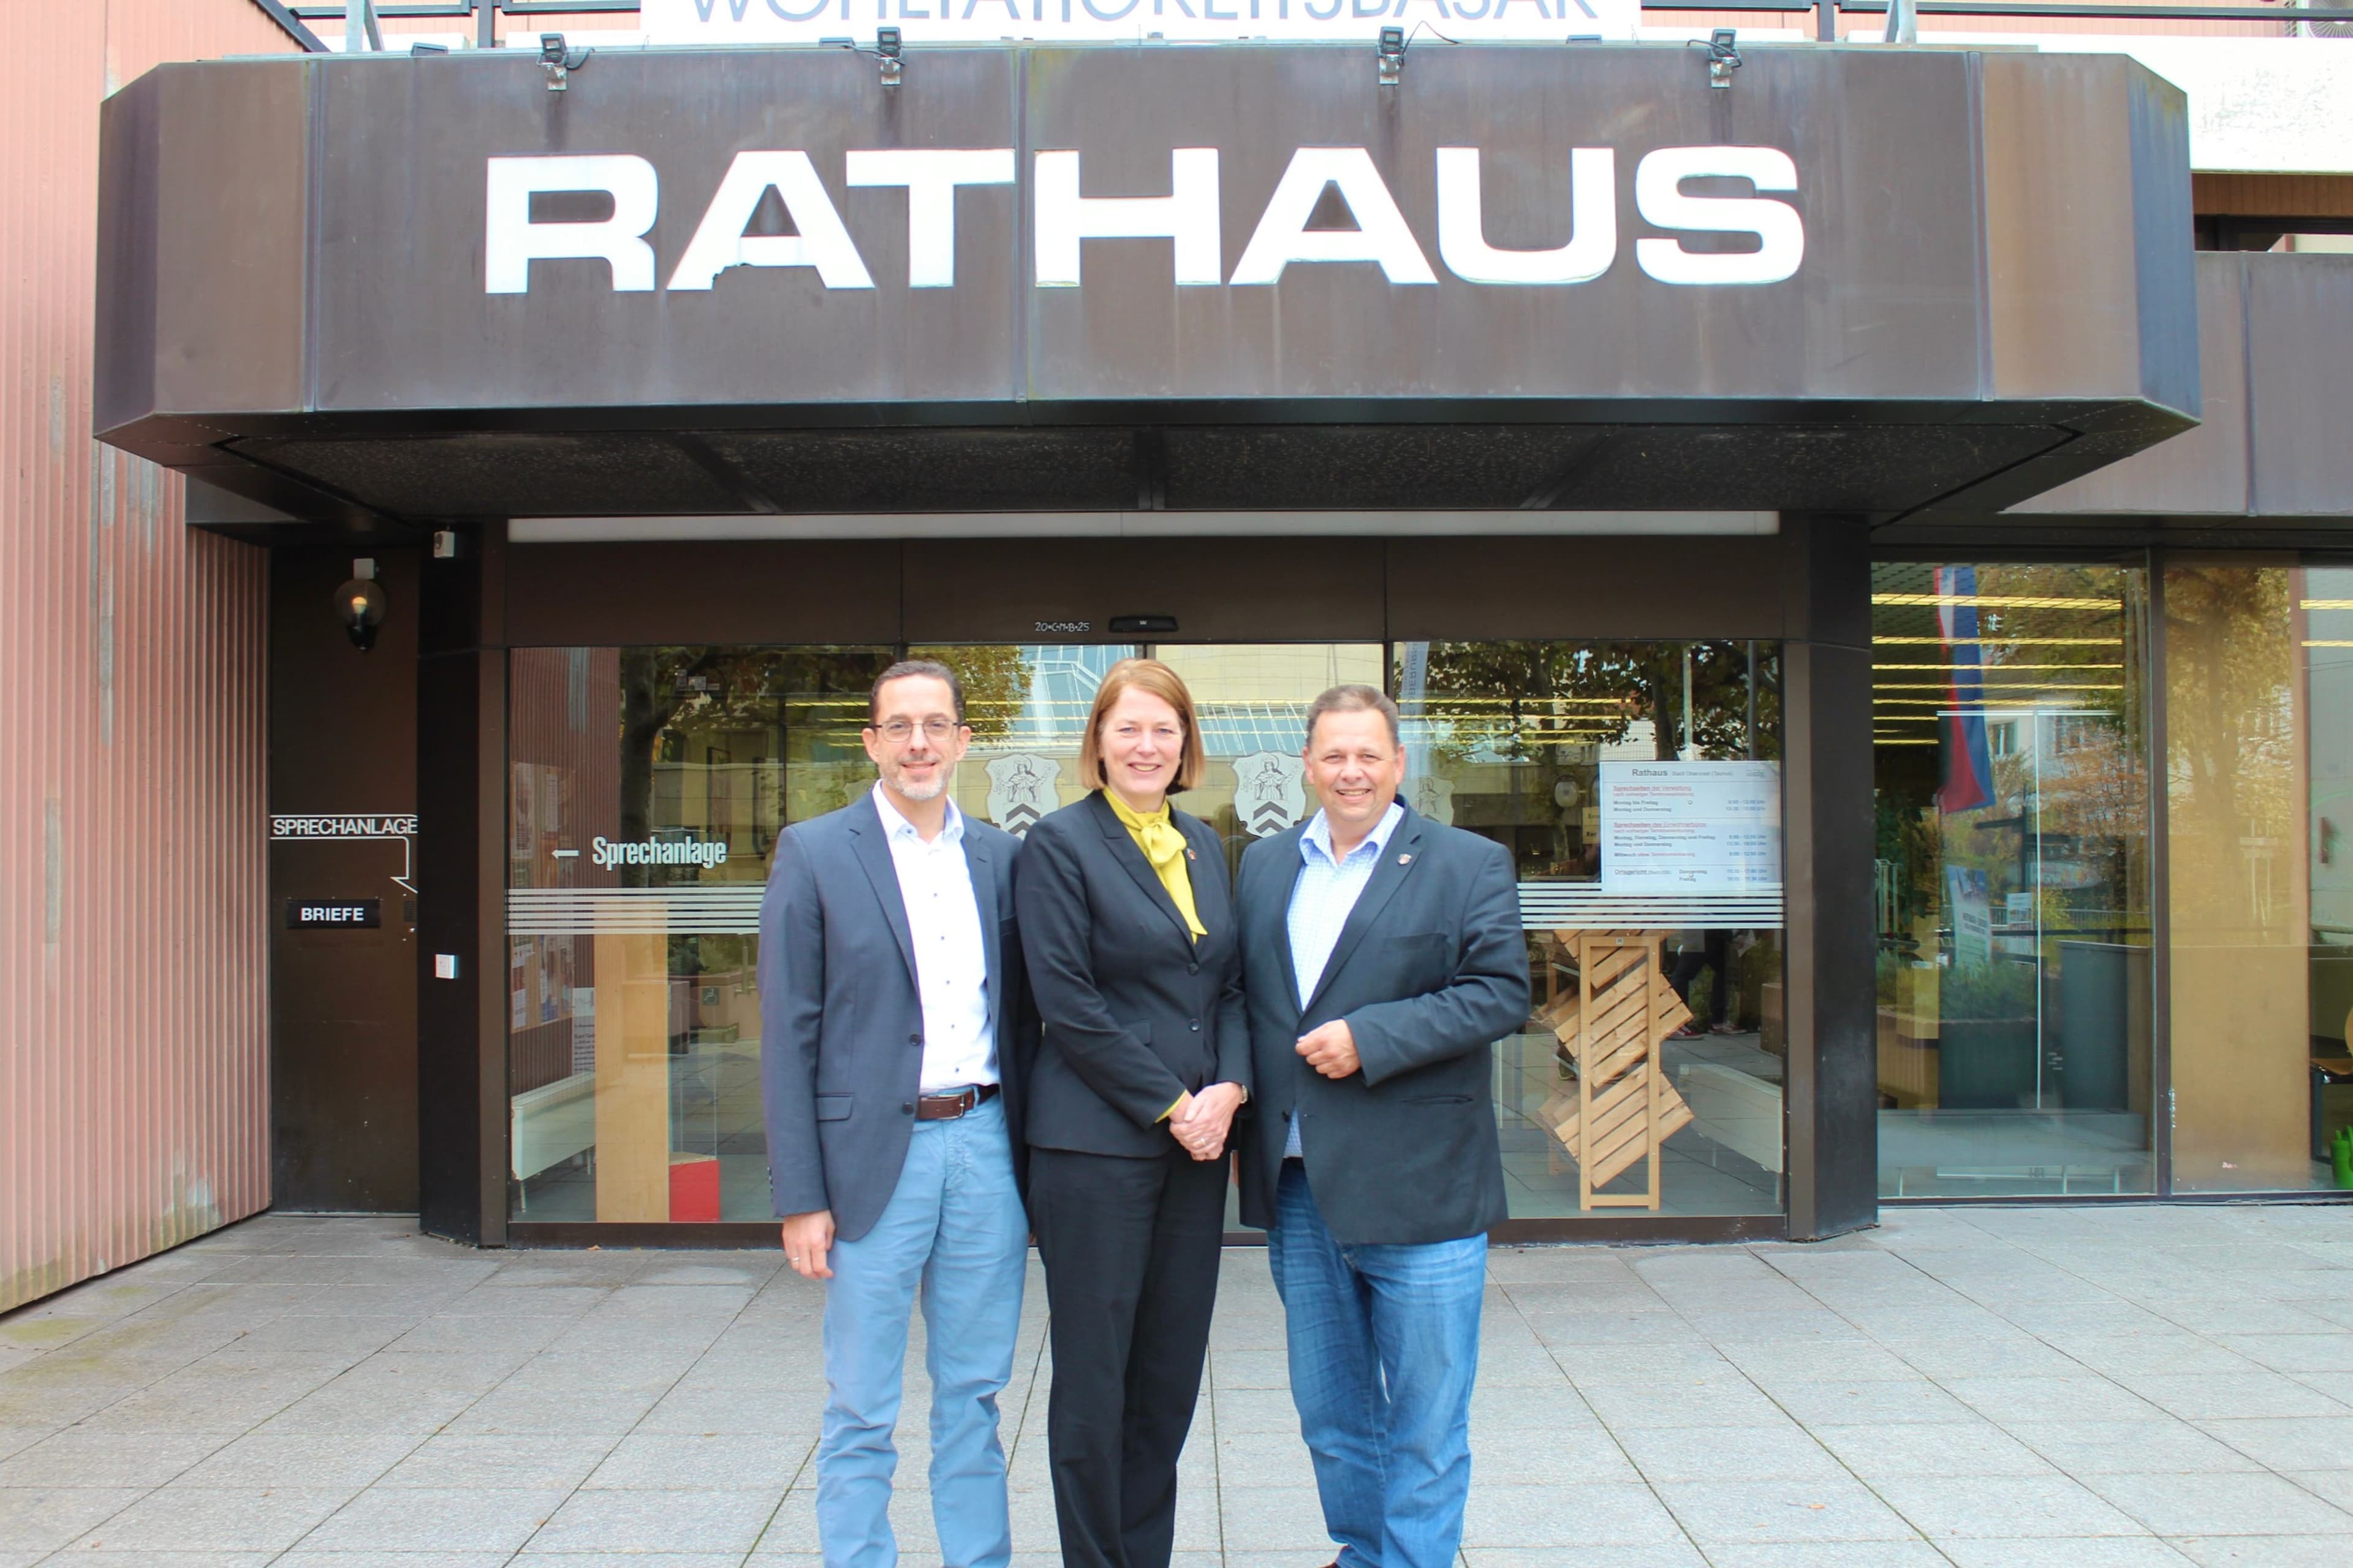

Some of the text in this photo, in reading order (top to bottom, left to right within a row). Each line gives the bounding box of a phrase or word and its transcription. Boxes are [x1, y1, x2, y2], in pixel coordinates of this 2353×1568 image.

[485, 146, 1804, 293] RATHAUS
[1632, 768, 1667, 777] Rathaus
[273, 818, 418, 835] SPRECHANLAGE
[592, 836, 727, 871] Sprechanlage
[301, 907, 364, 922] BRIEFE
